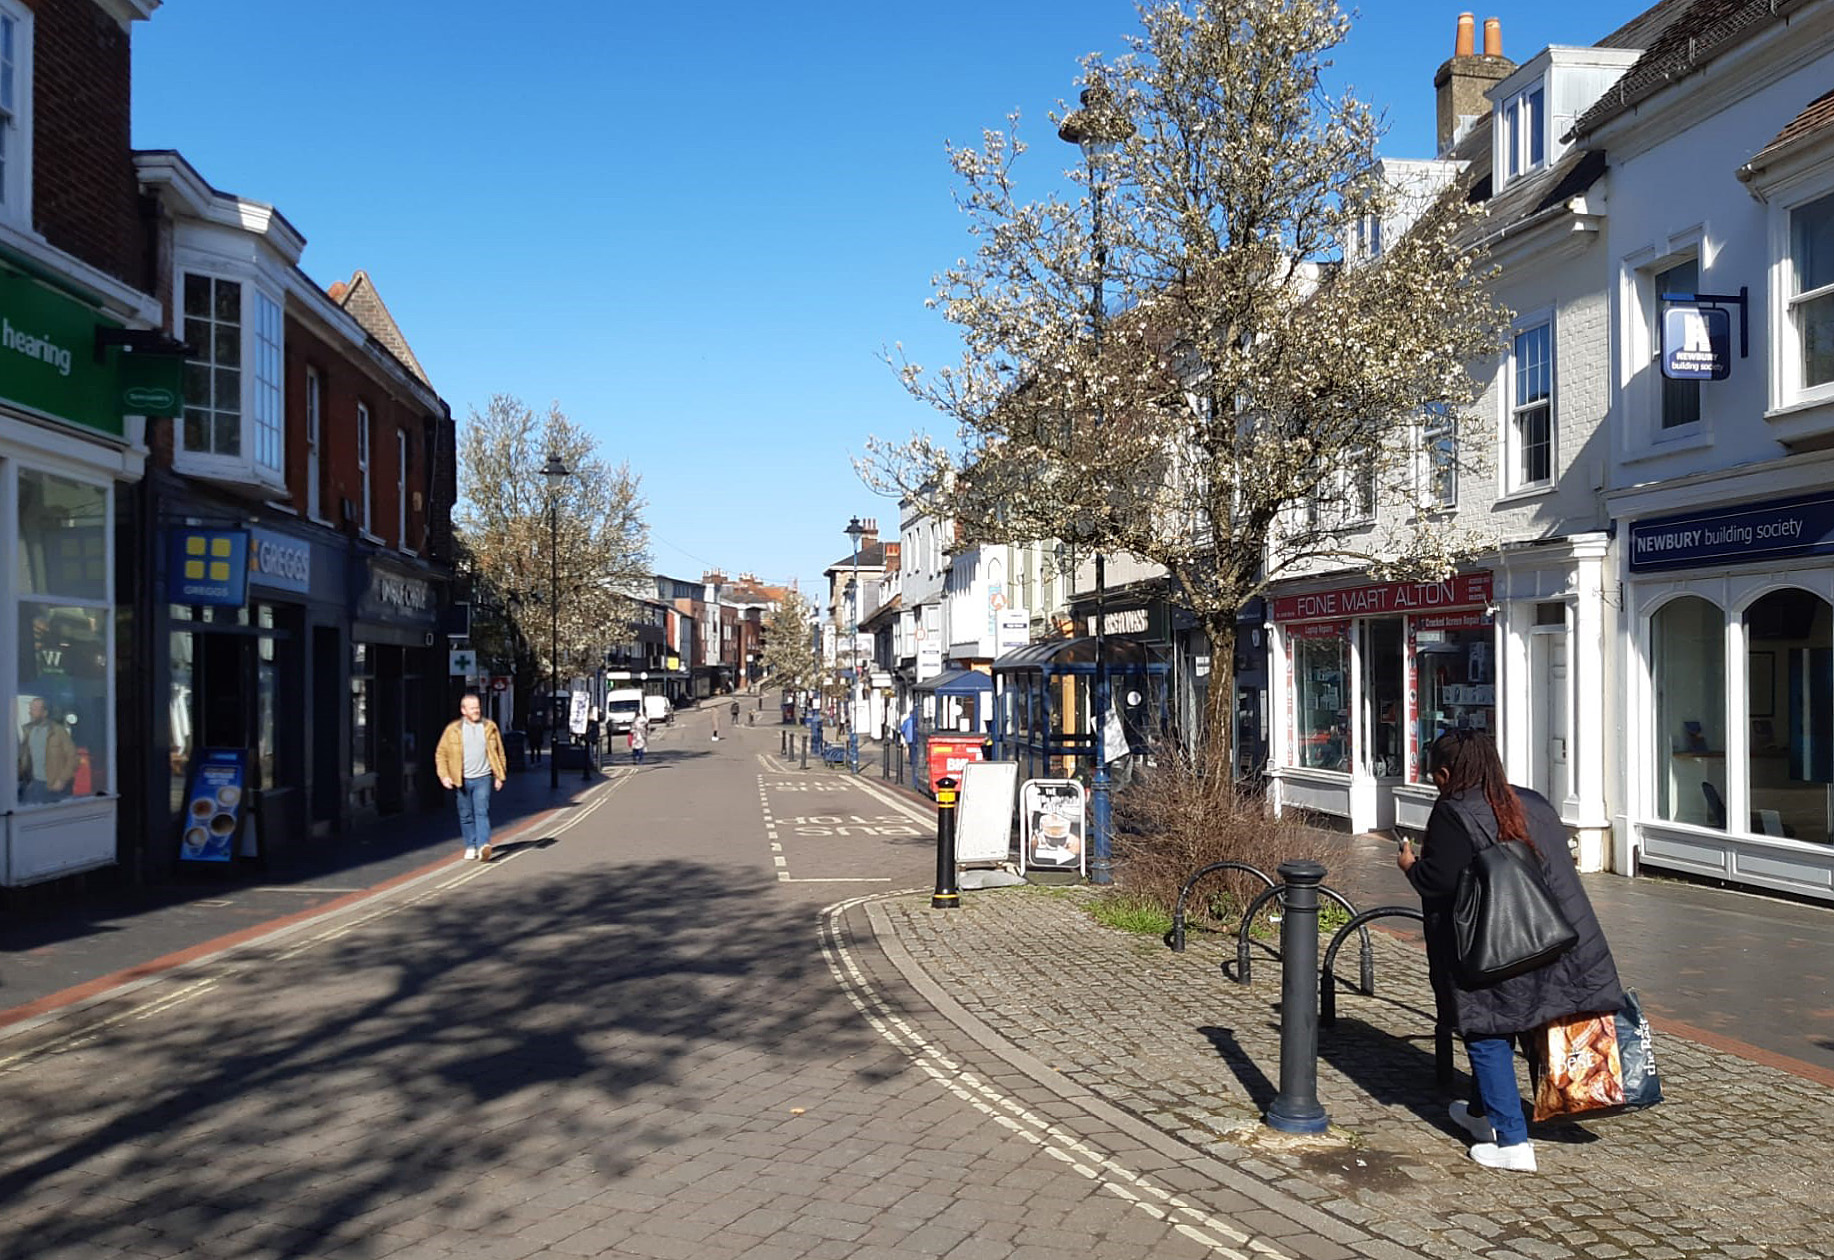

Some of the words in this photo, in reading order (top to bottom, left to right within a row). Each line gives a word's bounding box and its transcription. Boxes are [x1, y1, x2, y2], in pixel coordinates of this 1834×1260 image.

[3, 317, 71, 376] hearing
[1676, 352, 1719, 361] NEWBURY
[1671, 361, 1699, 372] building
[1637, 530, 1701, 553] NEWBURY
[1705, 524, 1752, 546] building
[1756, 518, 1803, 539] society
[260, 541, 309, 584] GREGGS
[183, 585, 230, 597] GREGGS
[1297, 594, 1337, 616] FONE
[1341, 588, 1388, 611] MART
[1394, 580, 1454, 608] ALTON
[794, 826, 922, 836] BUS
[1643, 1050, 1657, 1076] the
